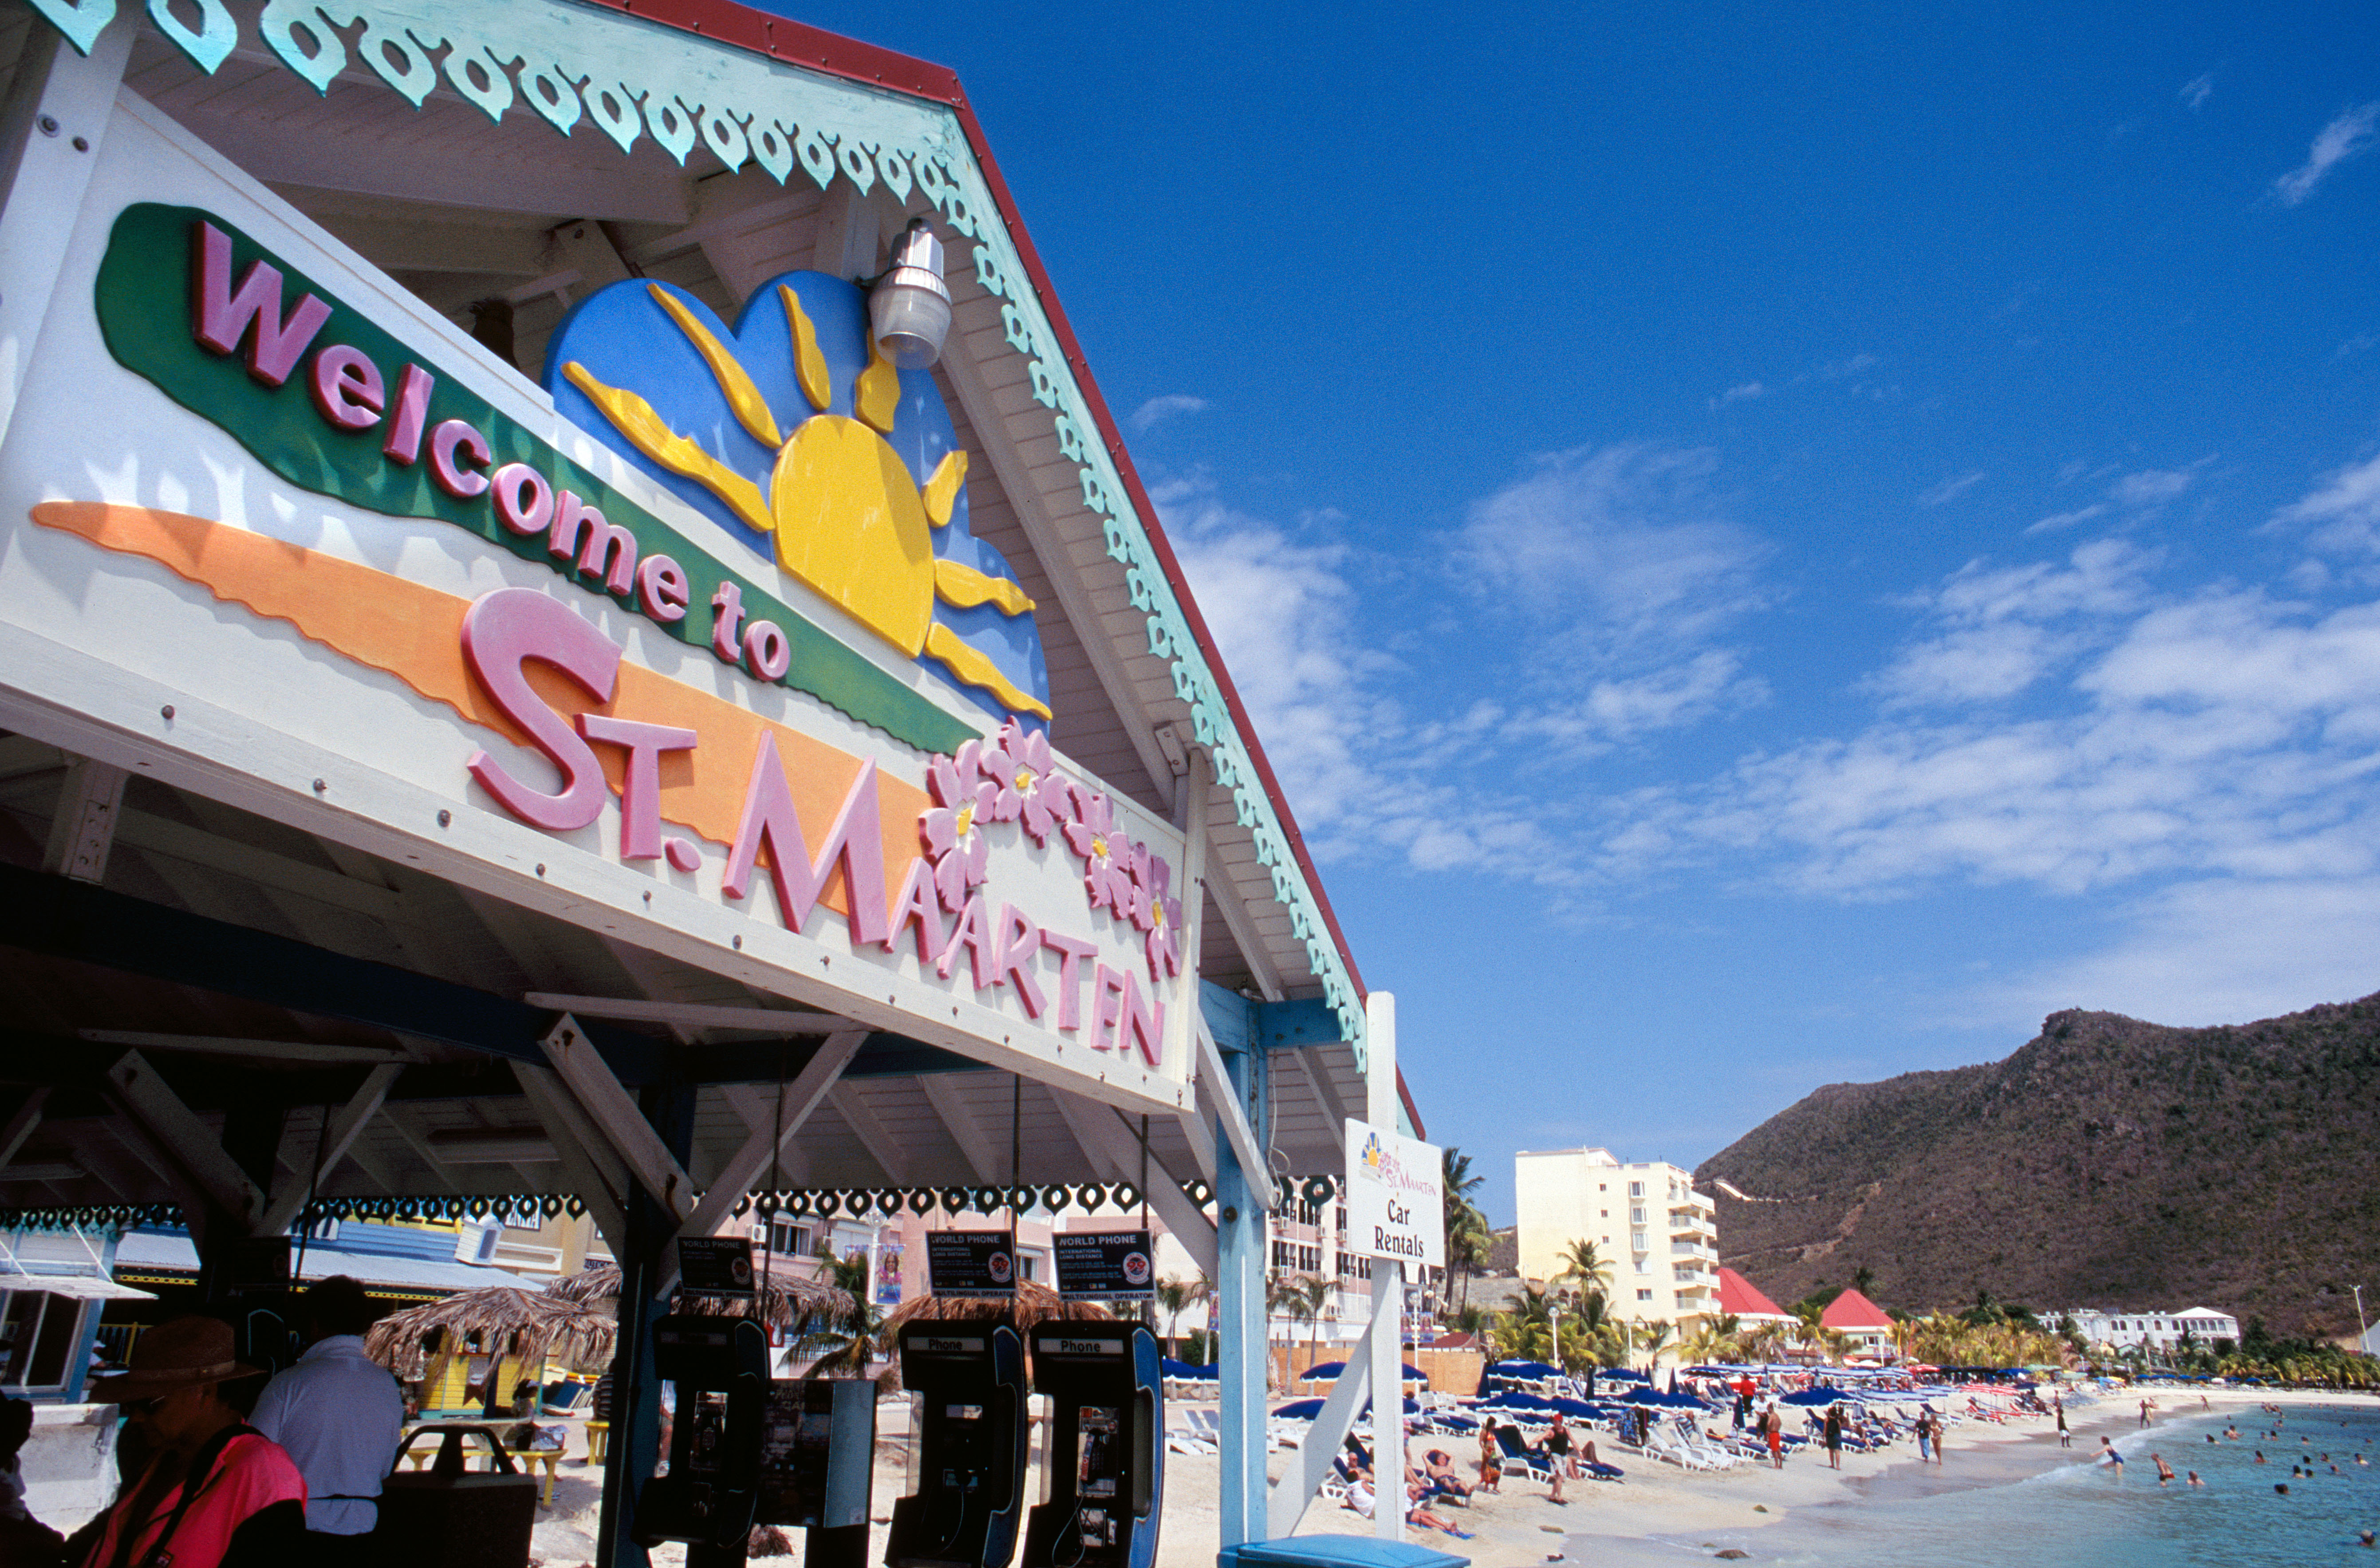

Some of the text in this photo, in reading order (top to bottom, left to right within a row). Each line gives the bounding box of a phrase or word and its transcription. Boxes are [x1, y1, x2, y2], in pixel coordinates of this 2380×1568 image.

[193, 221, 790, 681] Welcome to
[721, 730, 1165, 1066] MAARTEN
[1388, 1199, 1410, 1225] Car
[712, 1241, 741, 1249] PHONE
[1099, 1235, 1136, 1245] PHONE
[1375, 1225, 1423, 1257] Rentals
[992, 1261, 1009, 1270] 99
[1127, 1261, 1146, 1271] 99
[929, 1338, 962, 1350] Phone
[1061, 1340, 1101, 1352] Phone
